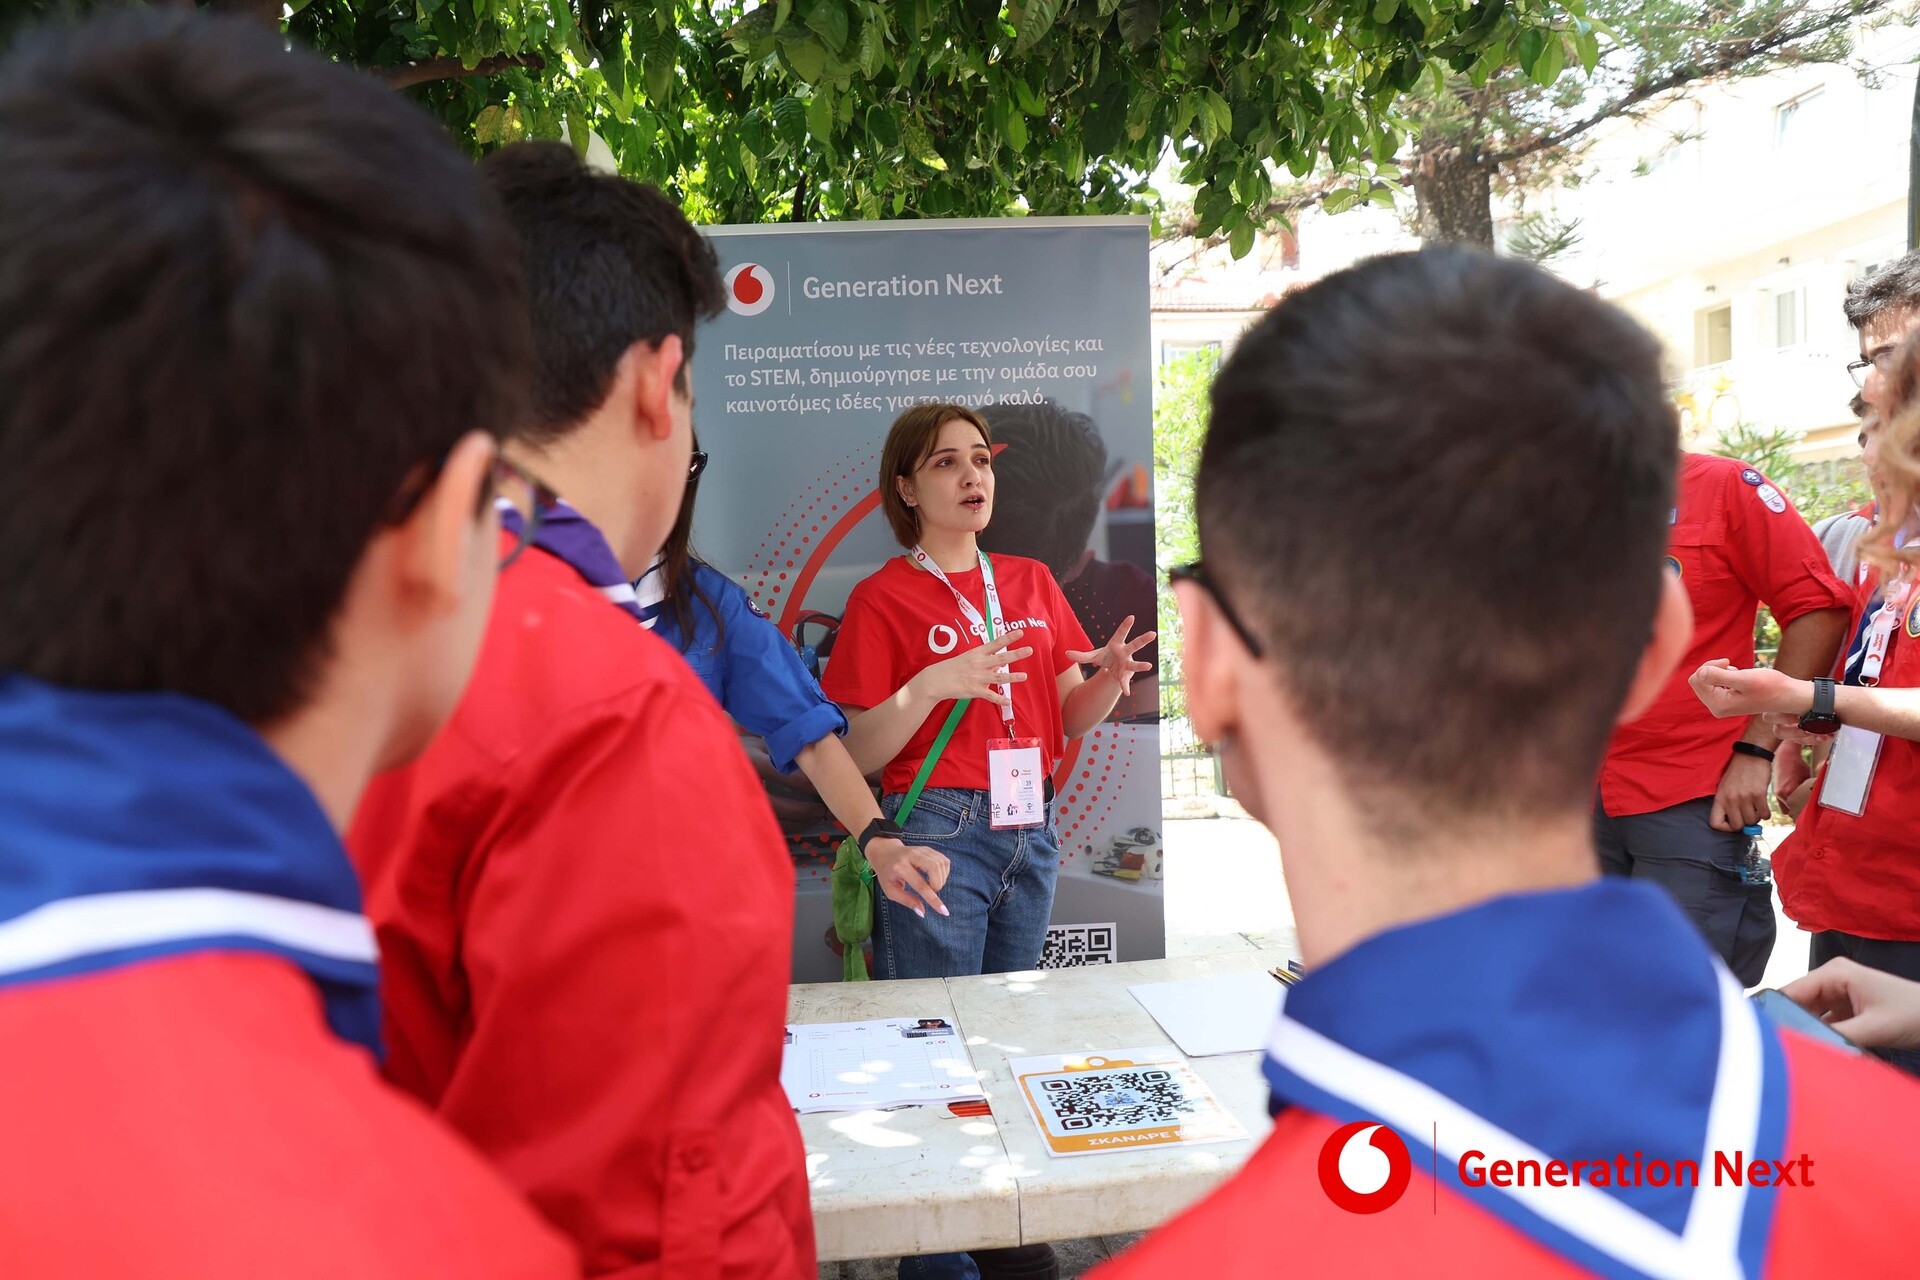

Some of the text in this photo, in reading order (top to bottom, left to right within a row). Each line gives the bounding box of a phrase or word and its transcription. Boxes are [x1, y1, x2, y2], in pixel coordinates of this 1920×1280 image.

[803, 273, 1003, 299] Generation Next
[724, 335, 1105, 363] Πειραματίσου με τις νέες τεχνολογίες και
[724, 361, 1098, 388] το STEM, δημιούργησε με την ομάδα σου
[726, 393, 831, 415] καινοτόμες
[835, 391, 882, 413] ιδέες
[885, 394, 915, 413] για
[945, 388, 995, 407] κοινό
[999, 387, 1049, 406] καλό.
[1088, 1131, 1172, 1146] ΣΚΑΝΑΡΕ
